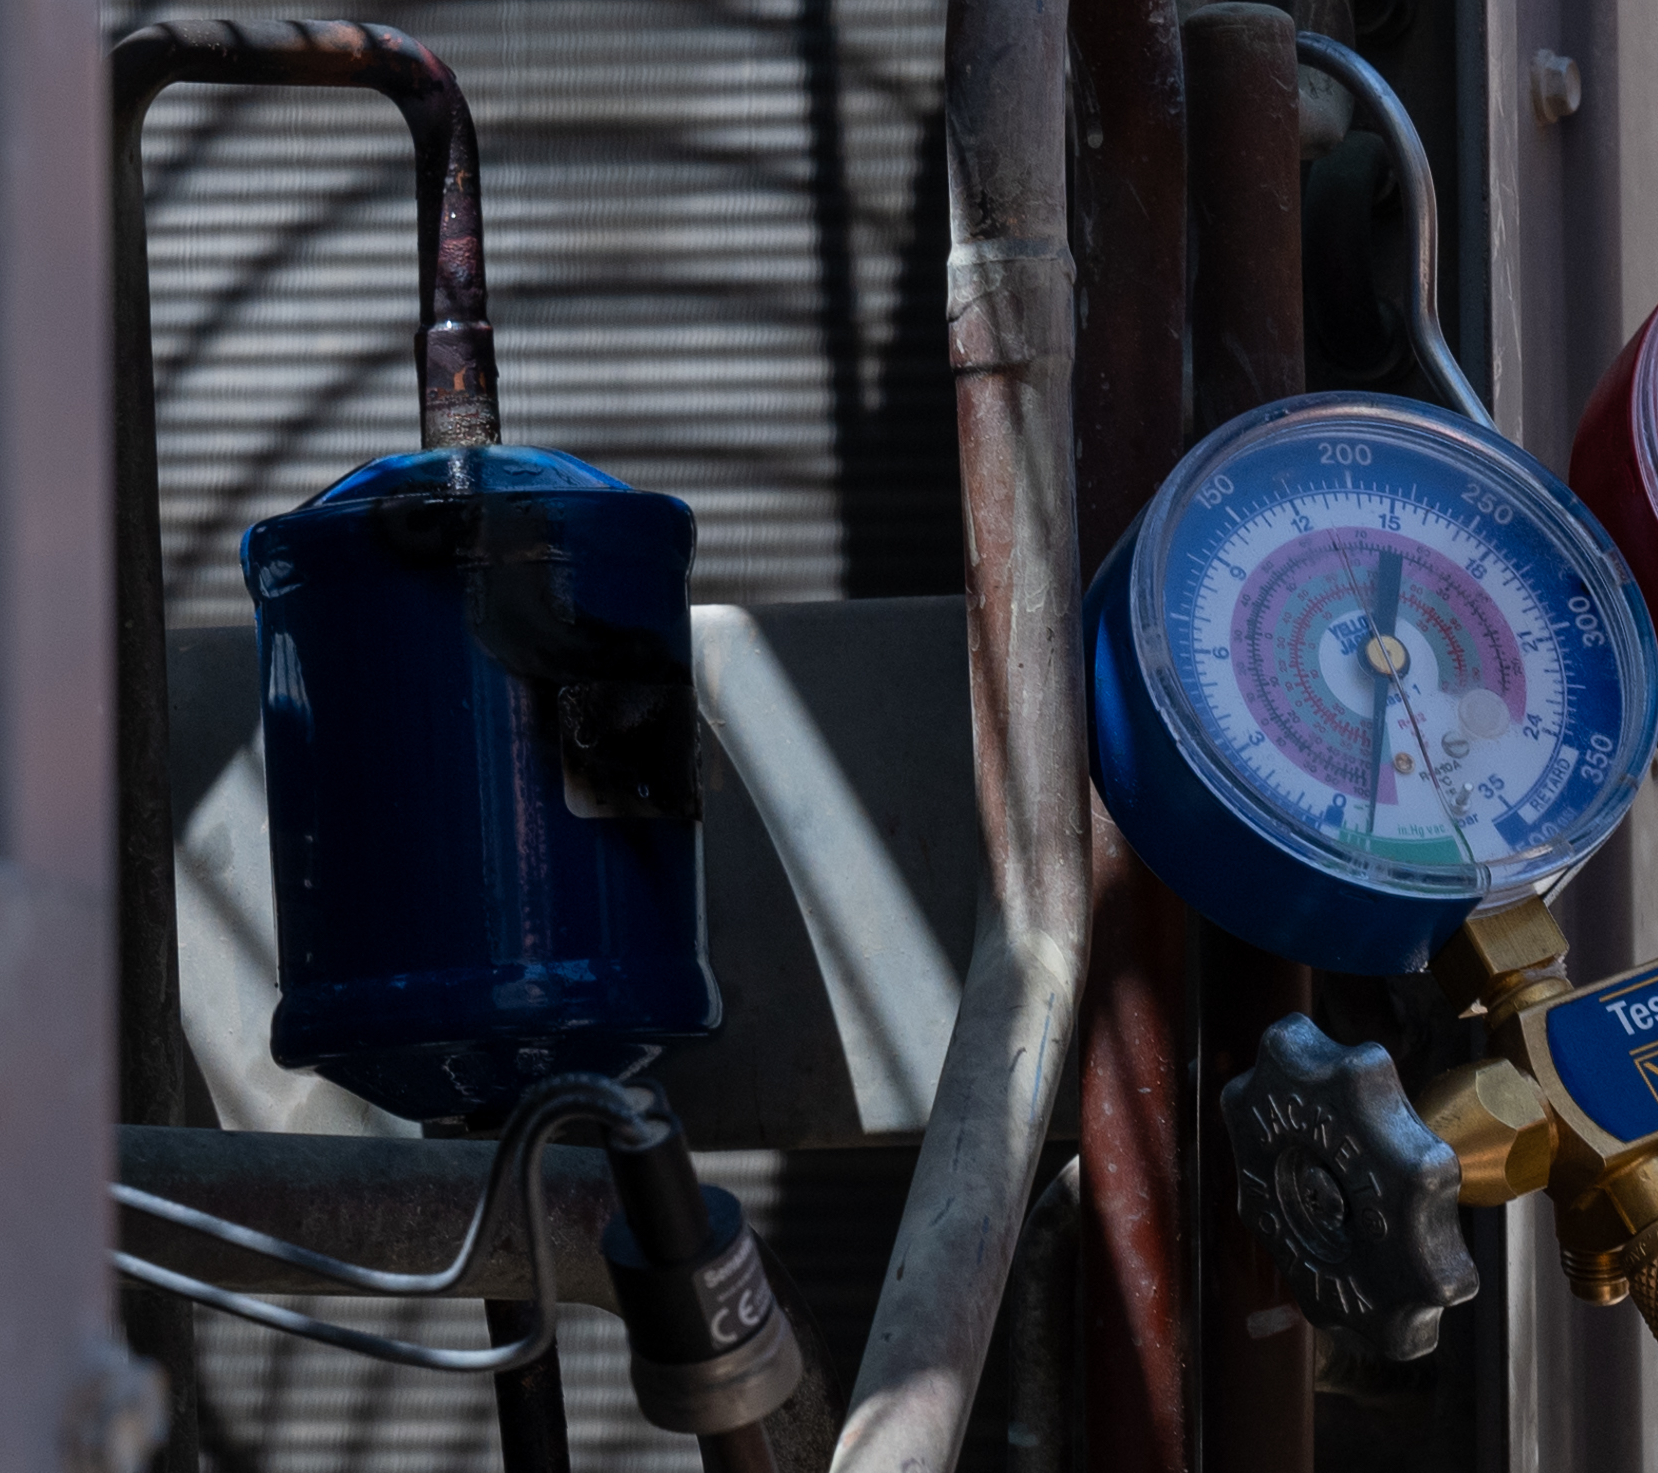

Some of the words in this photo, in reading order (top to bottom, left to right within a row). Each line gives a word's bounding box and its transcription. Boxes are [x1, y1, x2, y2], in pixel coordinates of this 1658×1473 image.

[1317, 442, 1373, 467] 200
[1195, 474, 1235, 510] 150
[1459, 482, 1513, 525] 250
[1290, 515, 1311, 533] 12
[1378, 513, 1402, 532] 15
[1229, 566, 1247, 580] 9
[1465, 557, 1488, 580] 18
[1567, 594, 1606, 648] 300
[1213, 646, 1231, 661] 6
[1517, 630, 1540, 653] 21
[1249, 731, 1265, 746] 3
[1522, 713, 1543, 740] 24
[1579, 732, 1615, 785] 350
[1478, 774, 1505, 800] 35
[1529, 757, 1572, 813] RETARD
[1332, 793, 1347, 809] 0
